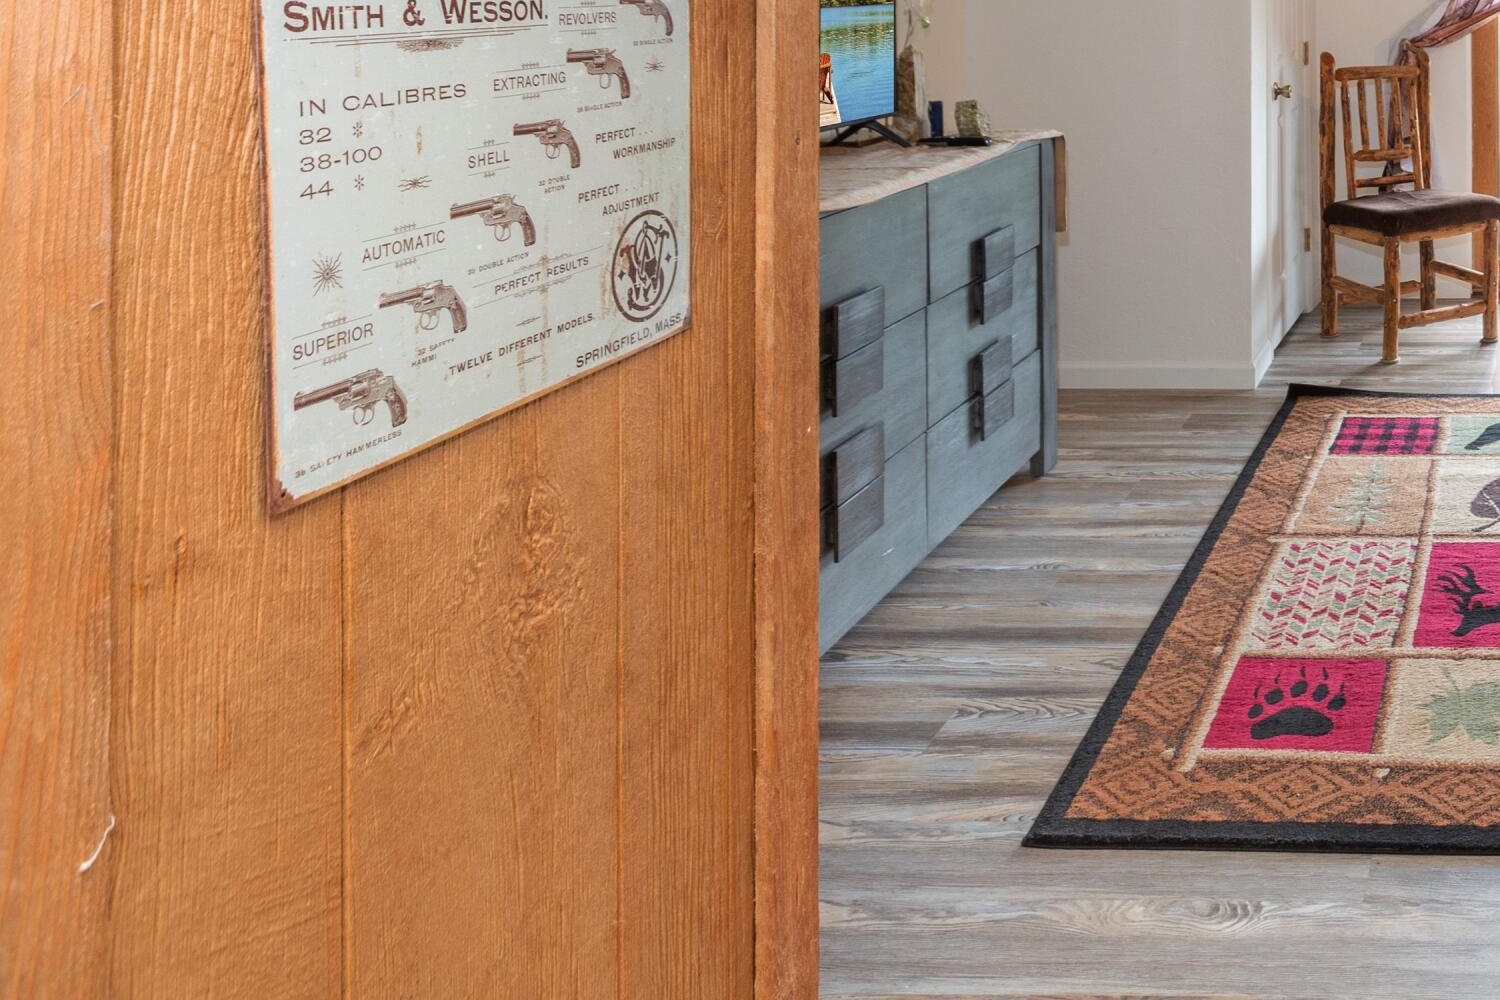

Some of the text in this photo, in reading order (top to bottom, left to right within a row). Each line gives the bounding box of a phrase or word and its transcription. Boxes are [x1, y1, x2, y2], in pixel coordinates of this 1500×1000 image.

[558, 11, 617, 26] REVOLVERS
[493, 71, 567, 92] EXTRACTING
[299, 83, 467, 117] IN CALIBRES
[299, 127, 332, 145] 32
[595, 127, 636, 145] PERFECT
[300, 146, 383, 173] 38-100
[467, 149, 511, 170] SHELL
[612, 137, 676, 160] WORKMANSHIP
[300, 180, 334, 200] 44
[578, 184, 620, 203] PERFECT
[602, 191, 660, 217] ADJUSTMENT
[362, 229, 446, 263] AUTOMATIC
[494, 256, 589, 295] PERFECT RESULTS
[292, 322, 374, 361] SUPERIOR
[449, 351, 494, 376] TWELVE
[498, 329, 552, 357] DIFFERENT
[576, 327, 653, 368] SPRINGFIELD,
